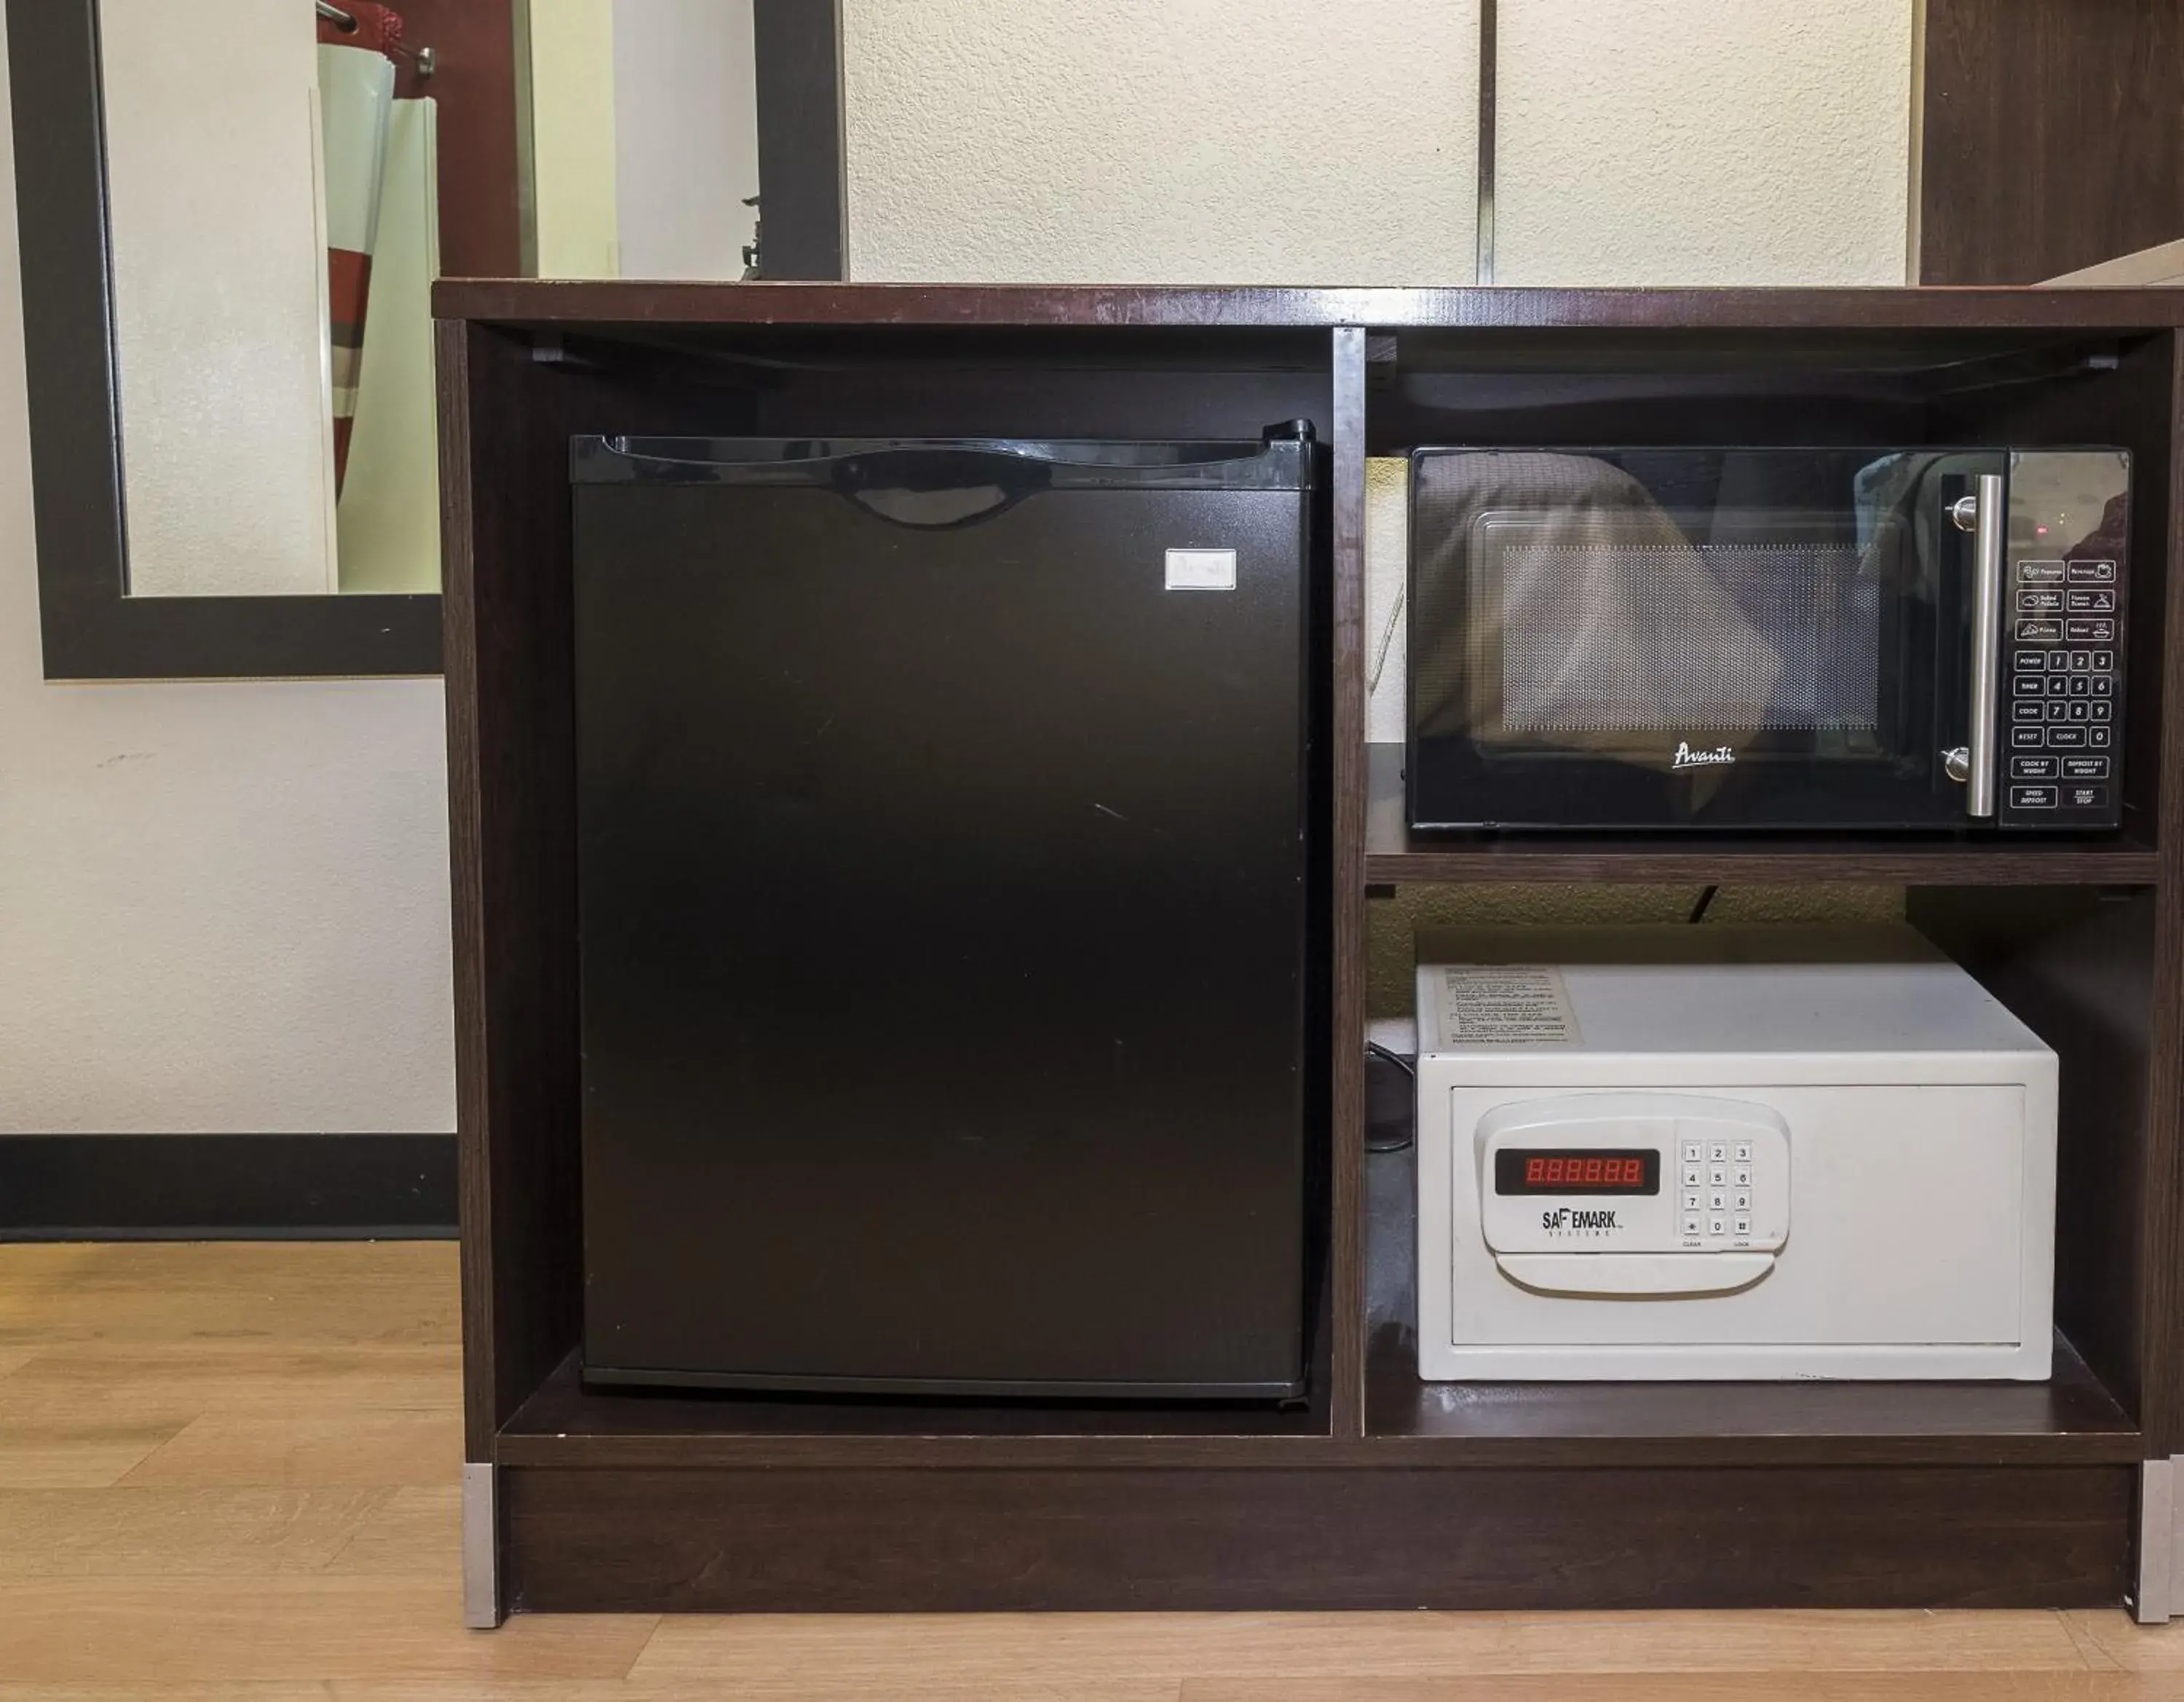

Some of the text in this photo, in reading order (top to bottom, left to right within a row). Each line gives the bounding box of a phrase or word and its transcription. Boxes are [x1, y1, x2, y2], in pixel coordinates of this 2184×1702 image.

[2076, 657, 2084, 666] 2
[2099, 657, 2105, 666] 3
[2054, 681, 2105, 691] 4 5 6
[2053, 706, 2105, 716] 7 8 9
[2096, 732, 2103, 741] 0
[1674, 741, 1733, 766] Avanti
[1714, 1149, 1722, 1157] 2
[1739, 1149, 1746, 1157] 3
[1714, 1173, 1722, 1181] 5
[1739, 1174, 1746, 1182] 6
[1689, 1198, 1745, 1206] 7 8 9
[1543, 1208, 1616, 1229] SAFEMARK
[1714, 1222, 1721, 1231] 0
